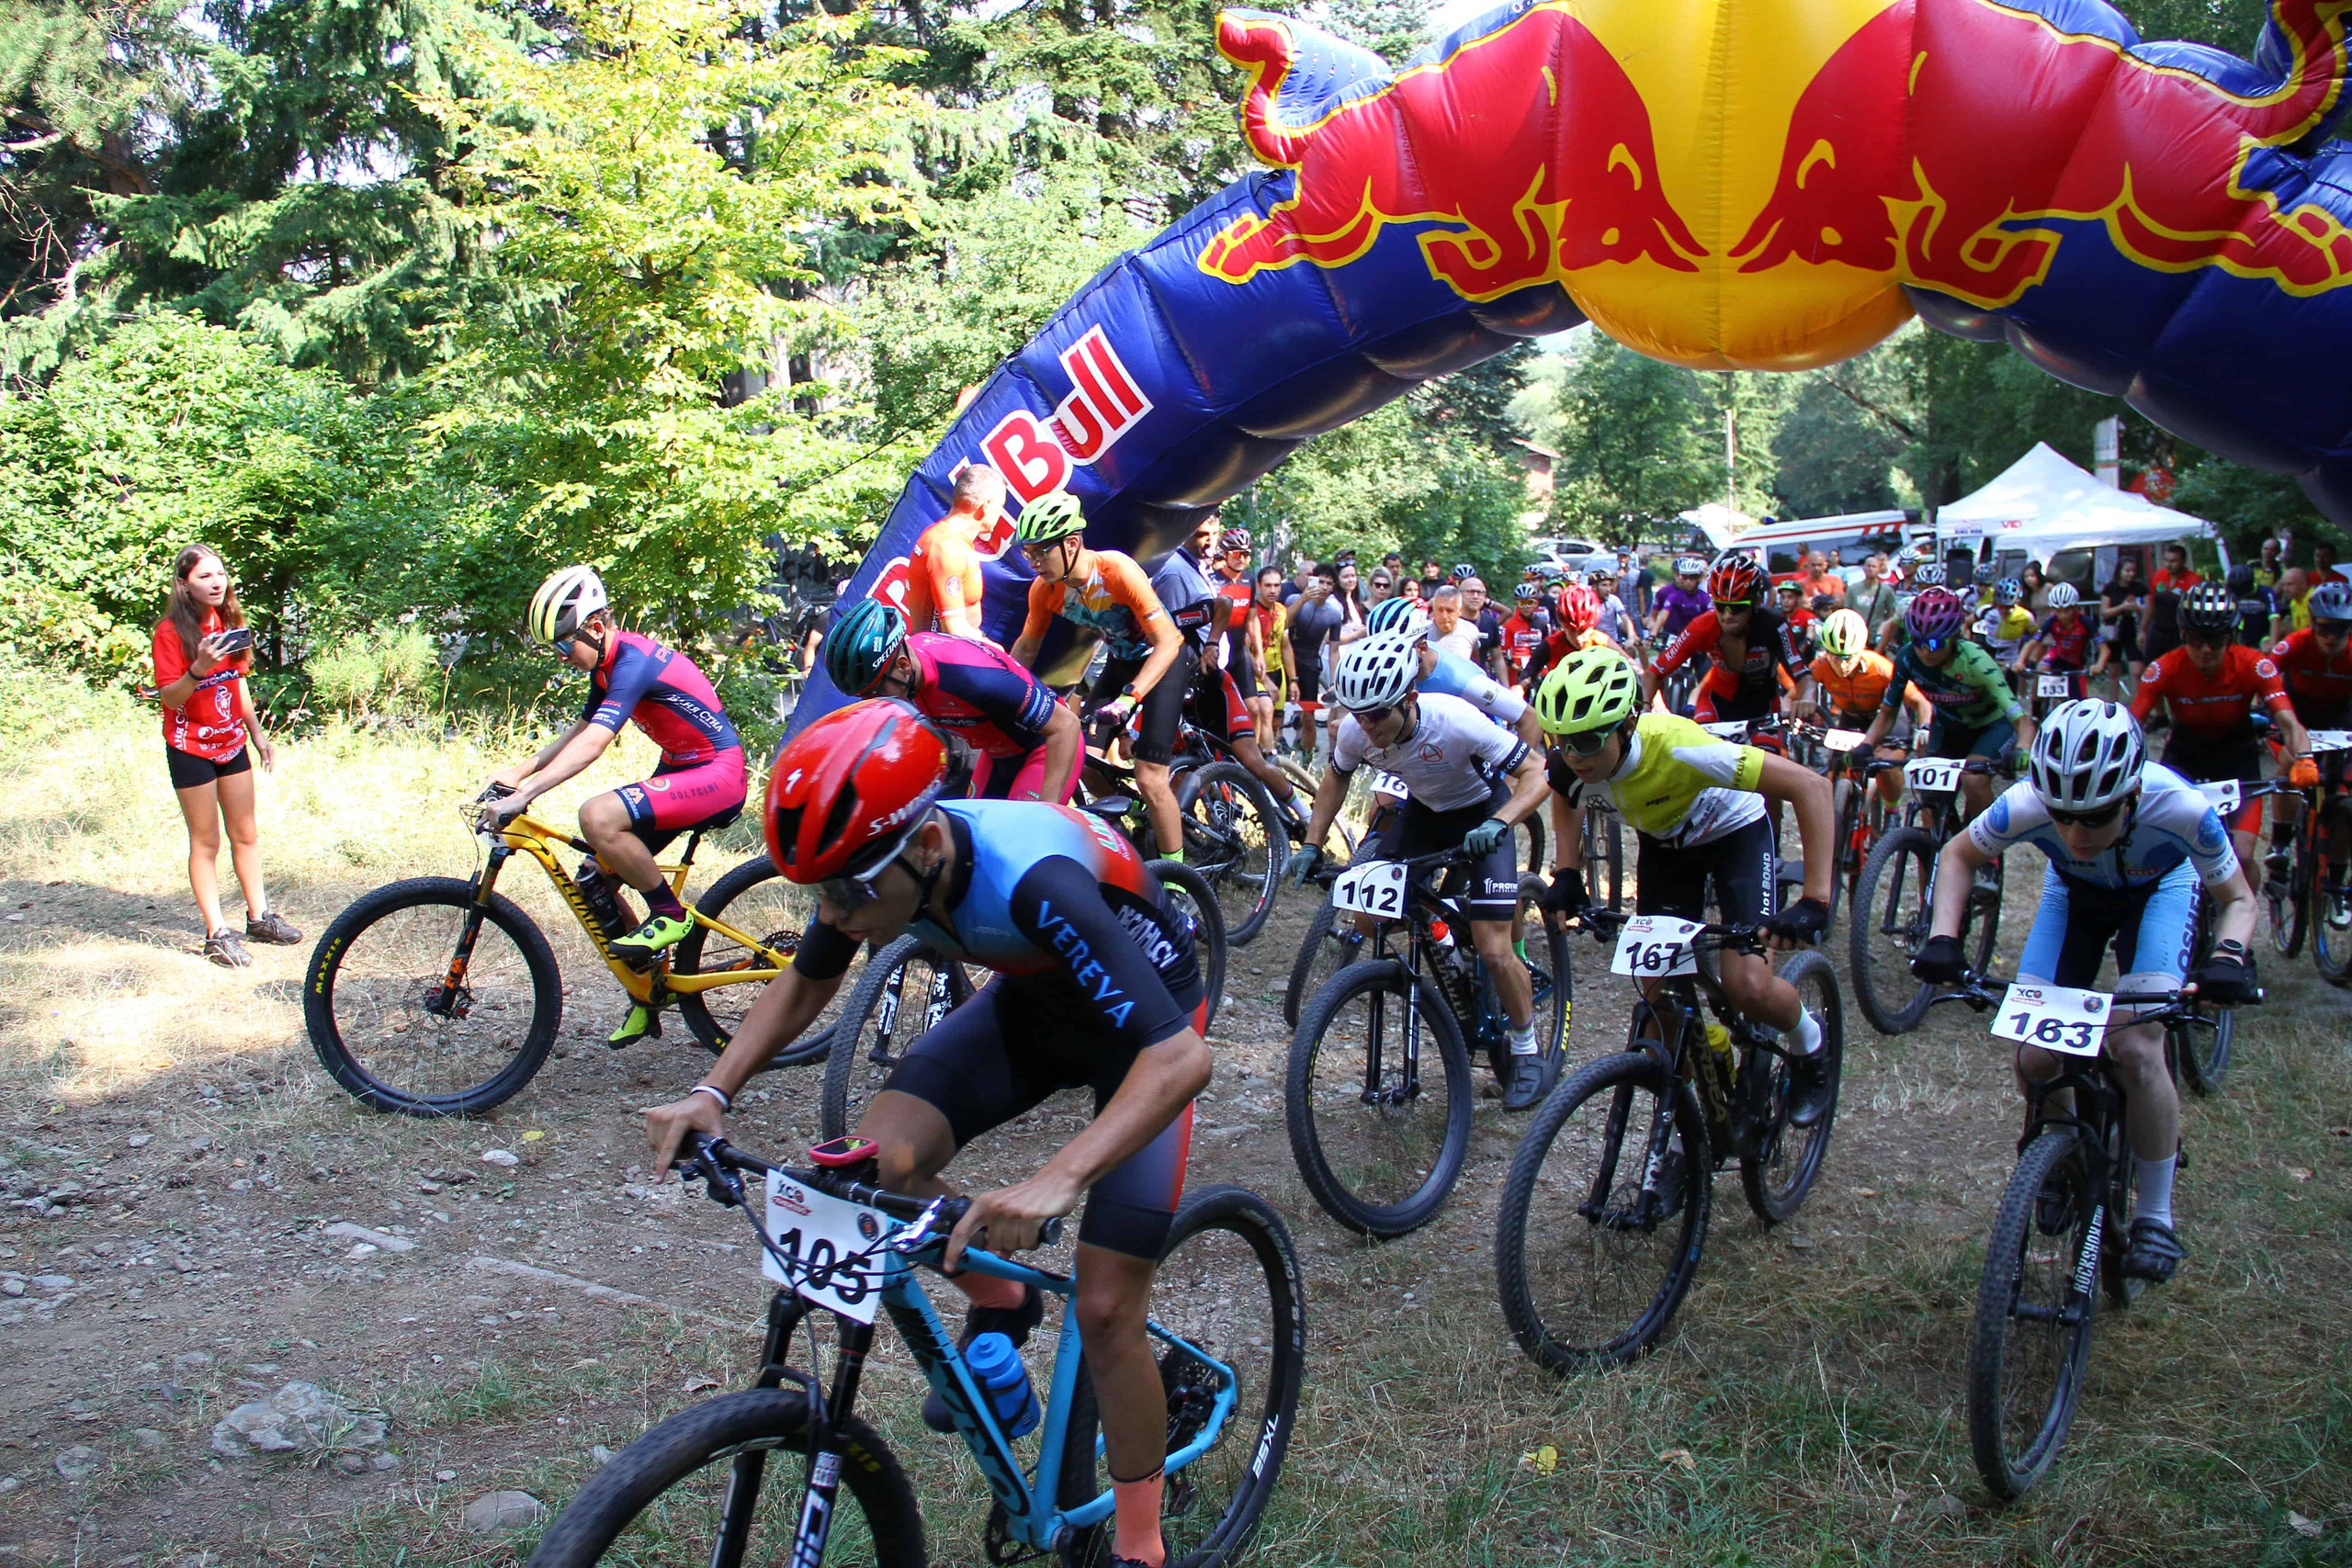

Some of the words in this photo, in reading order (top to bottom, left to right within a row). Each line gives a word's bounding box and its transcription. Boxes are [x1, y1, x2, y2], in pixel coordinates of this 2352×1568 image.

[979, 323, 1154, 510] Bull
[872, 626, 907, 671] SPECIALIZ
[2041, 685, 2064, 695] 133
[669, 782, 720, 800] DOLTCINI
[1909, 768, 1951, 787] 101
[1341, 880, 1398, 913] 112
[314, 937, 342, 995] MAXXIS
[1037, 900, 1135, 1028] VEREVA
[1625, 942, 1683, 971] 167
[2017, 988, 2042, 999] XCO
[2009, 1012, 2094, 1049] 163
[779, 1226, 873, 1305] 105
